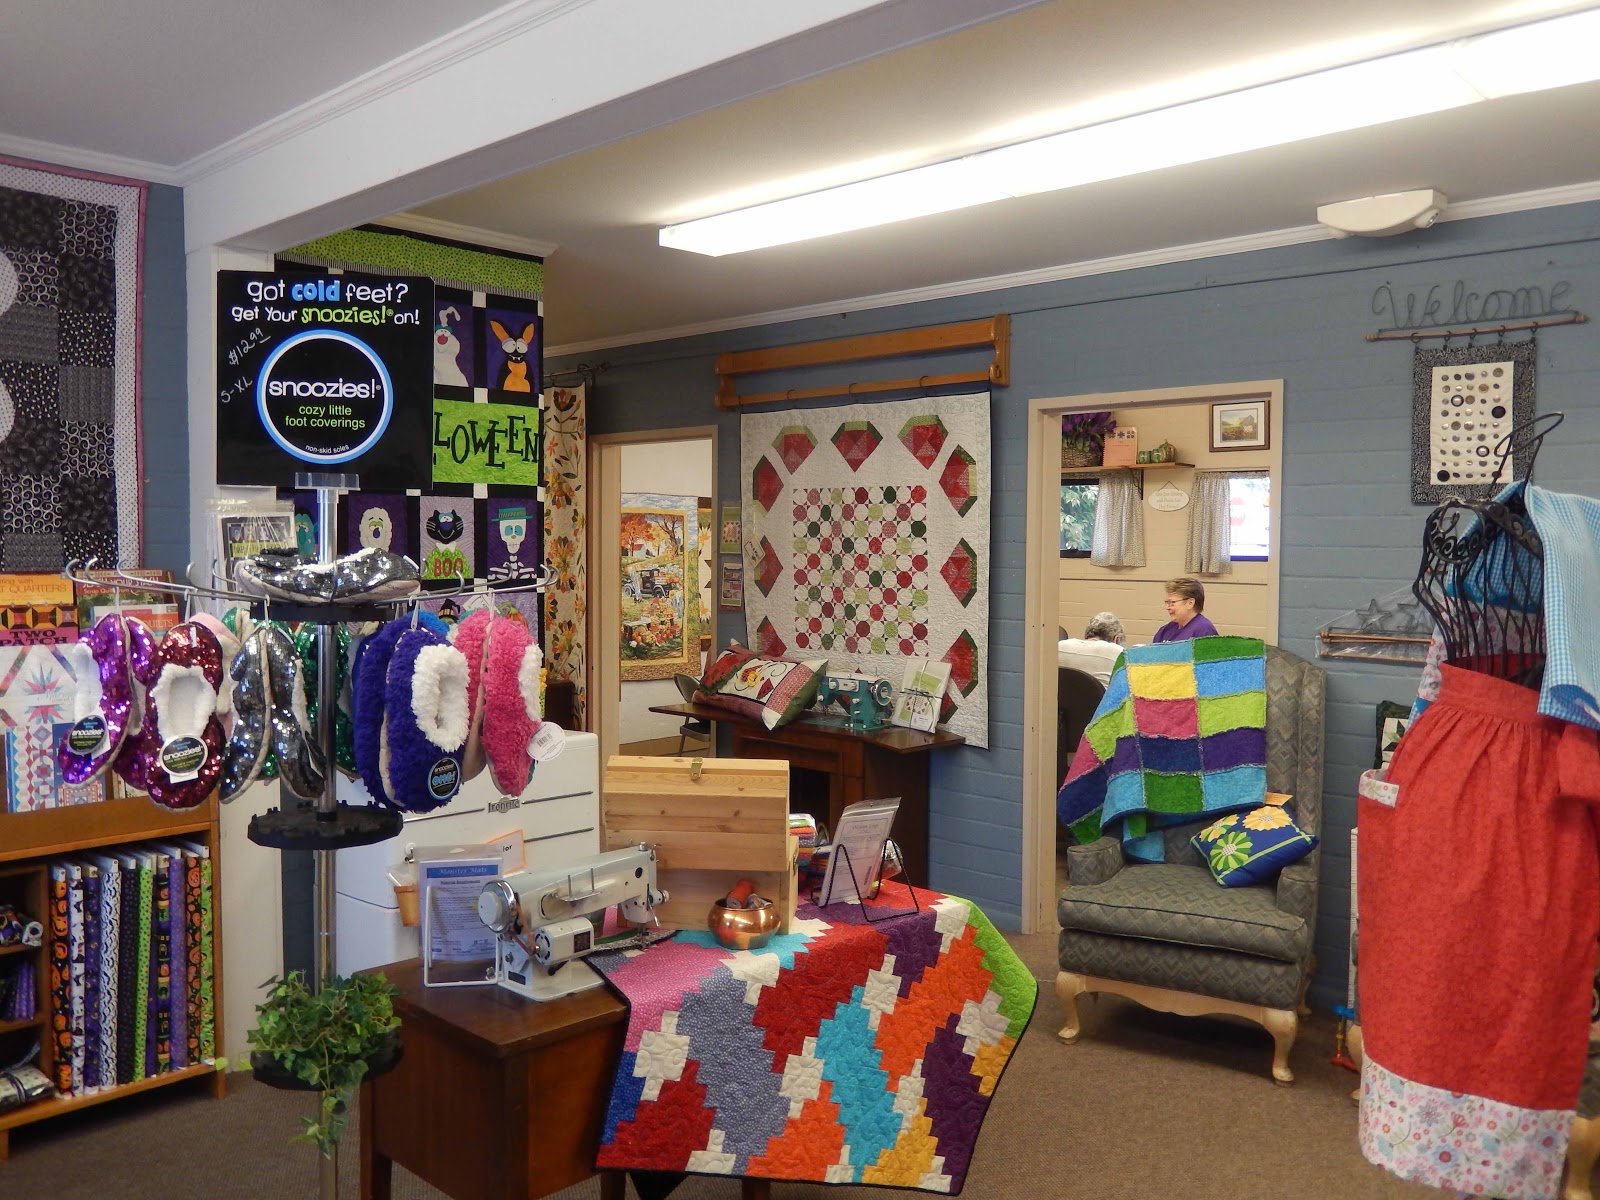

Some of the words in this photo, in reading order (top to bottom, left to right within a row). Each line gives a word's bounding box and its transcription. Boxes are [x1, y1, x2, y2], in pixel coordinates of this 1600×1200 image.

[247, 279, 285, 302] got
[291, 280, 340, 301] cold
[345, 283, 409, 303] feet?
[1371, 279, 1572, 328] Welcome
[231, 305, 259, 321] get
[394, 309, 420, 325] on!
[298, 405, 326, 418] cozy
[329, 404, 352, 416] little
[285, 415, 307, 427] foot
[310, 418, 366, 431] coverings
[432, 411, 545, 470] LOWEEN
[305, 444, 332, 454] non-skid
[333, 444, 350, 454] soles
[433, 557, 464, 577] BOO
[9, 584, 67, 594] QUARTERS
[0, 637, 69, 647] PATCH
[9, 630, 57, 639] TWO
